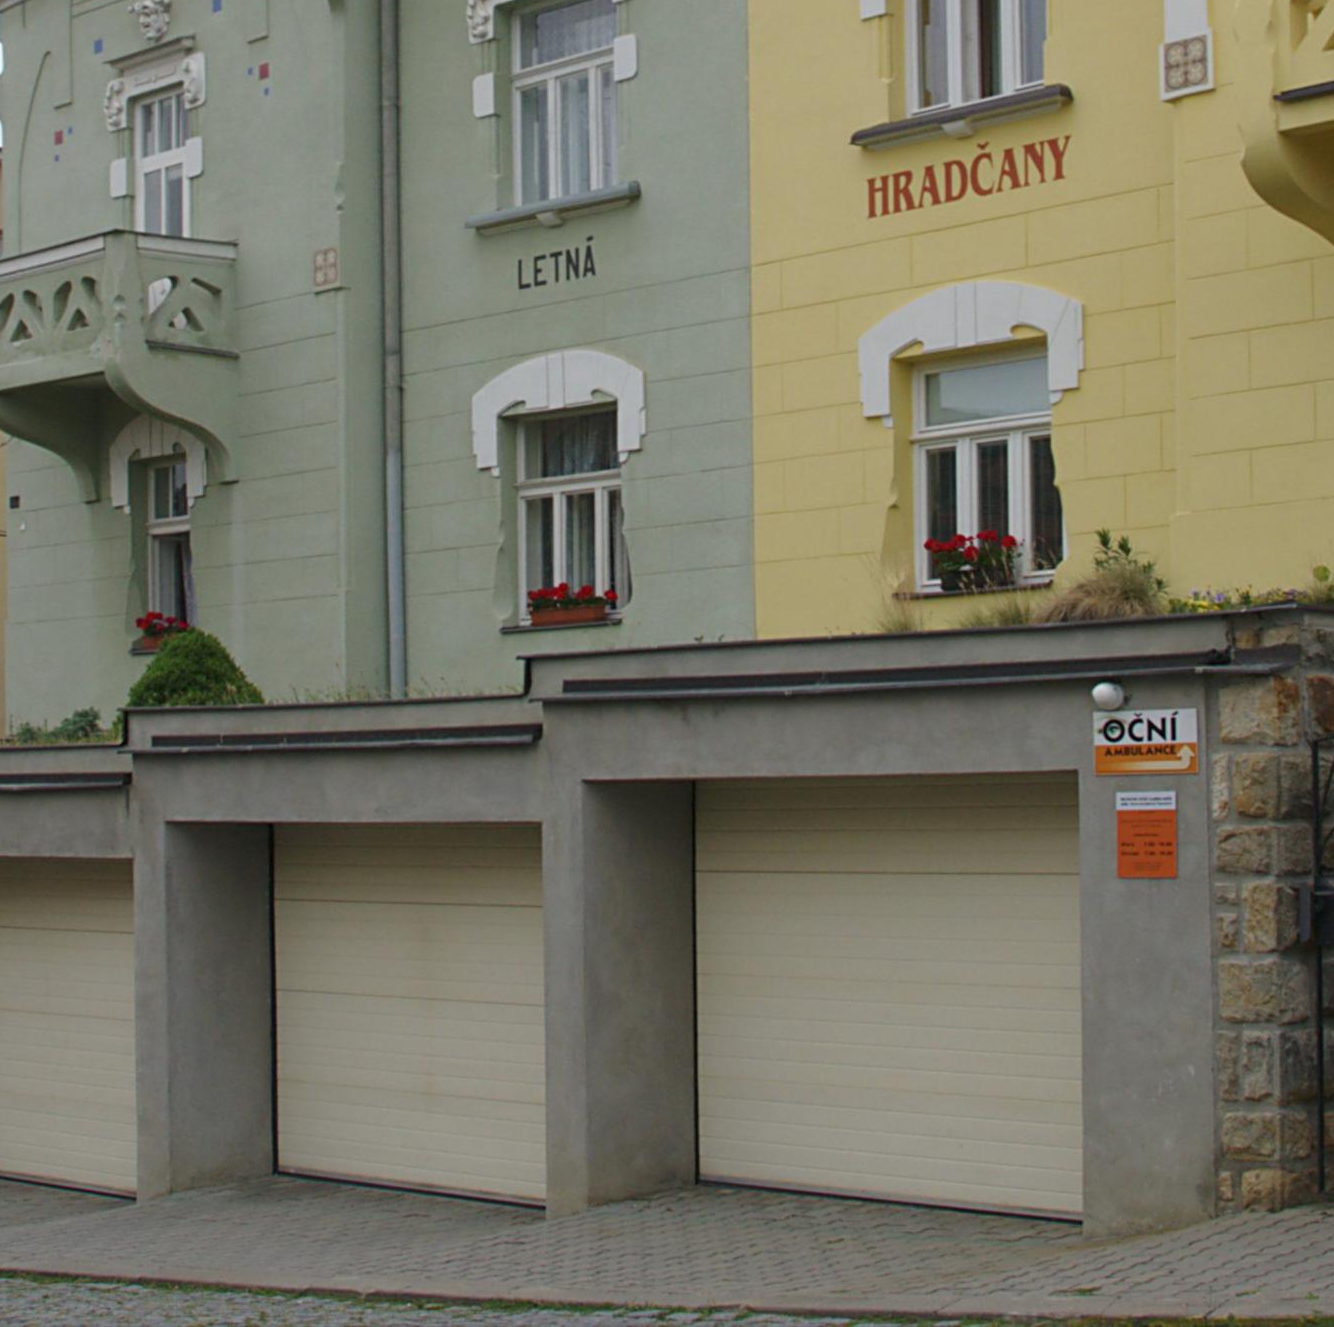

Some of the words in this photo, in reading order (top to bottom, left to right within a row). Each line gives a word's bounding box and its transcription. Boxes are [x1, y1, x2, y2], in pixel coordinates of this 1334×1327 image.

[866, 135, 1071, 219] HRADČANY
[518, 235, 596, 290] LETNÁ
[1103, 710, 1179, 743] OČNÍ
[1104, 745, 1177, 757] AMBULANCE
